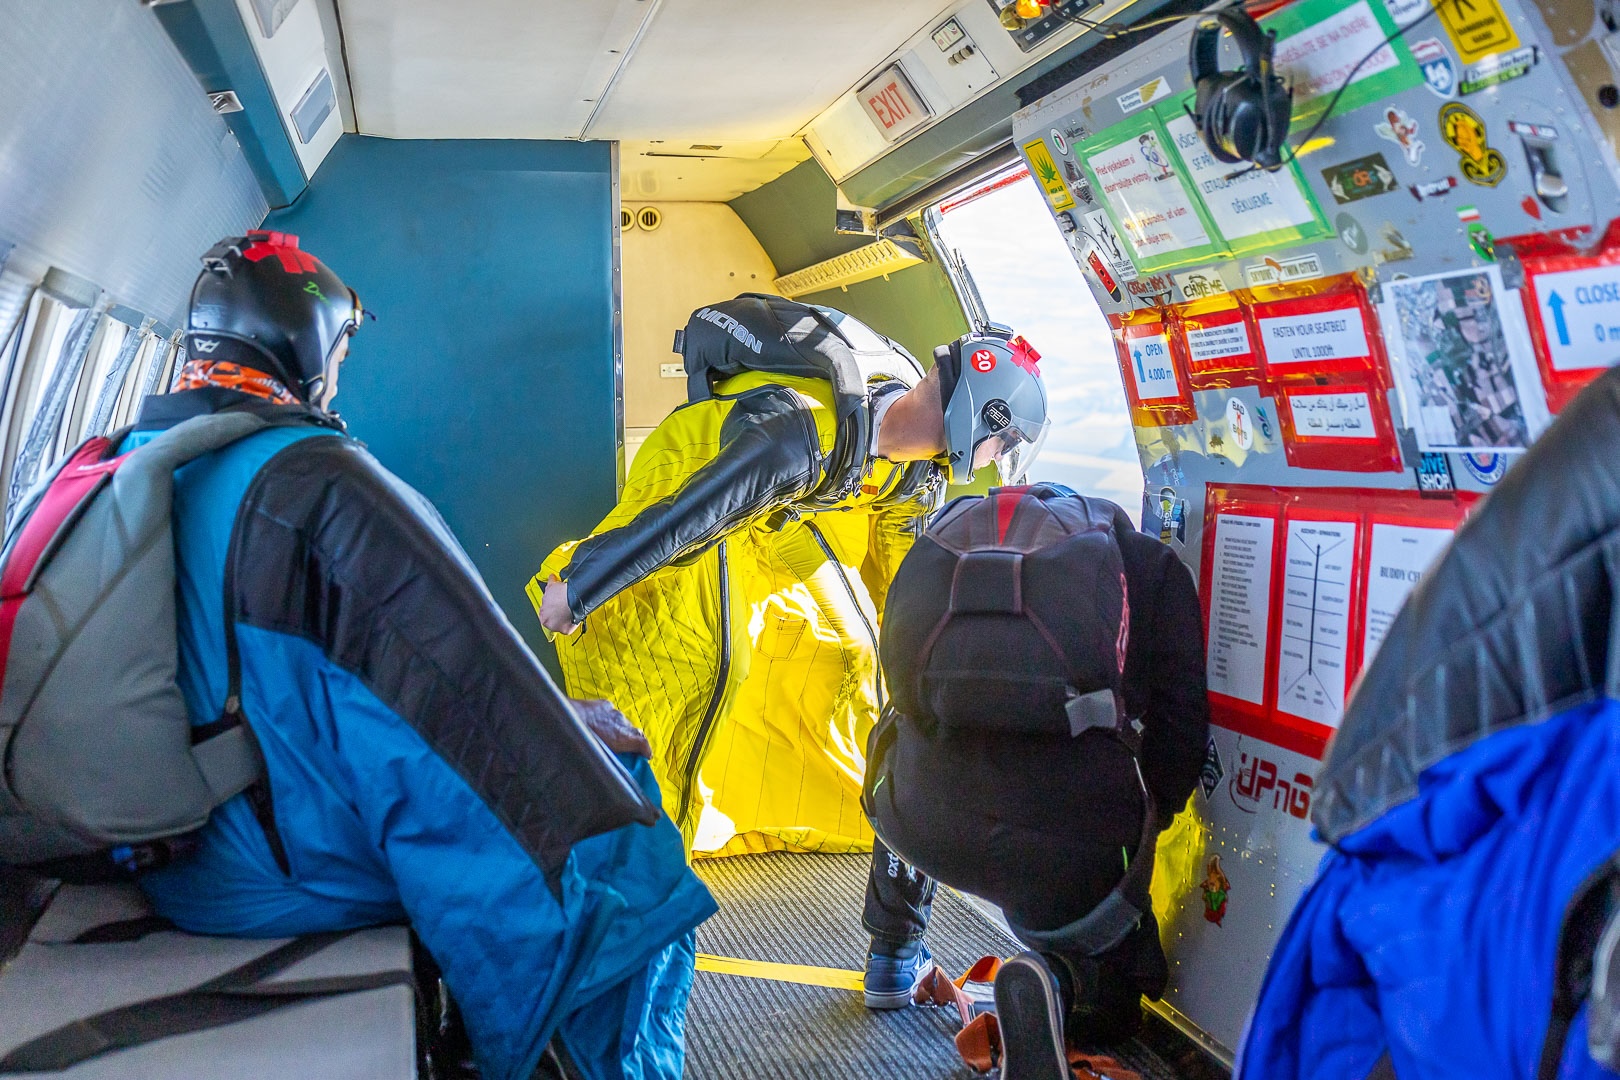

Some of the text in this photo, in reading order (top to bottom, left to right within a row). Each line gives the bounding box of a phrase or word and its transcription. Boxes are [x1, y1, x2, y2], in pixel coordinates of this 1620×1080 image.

[868, 82, 911, 129] EXIT
[696, 307, 763, 354] MICRON
[1272, 319, 1347, 338] FASTEN YOUR SEATBELT
[1594, 323, 1606, 342] 0
[1145, 343, 1163, 357] OPEN
[1291, 344, 1335, 359] UNTIL 1000ft
[976, 352, 992, 371] 20
[1166, 370, 1174, 380] m
[1422, 473, 1450, 491] SHOP
[1380, 566, 1406, 581] BUDDY
